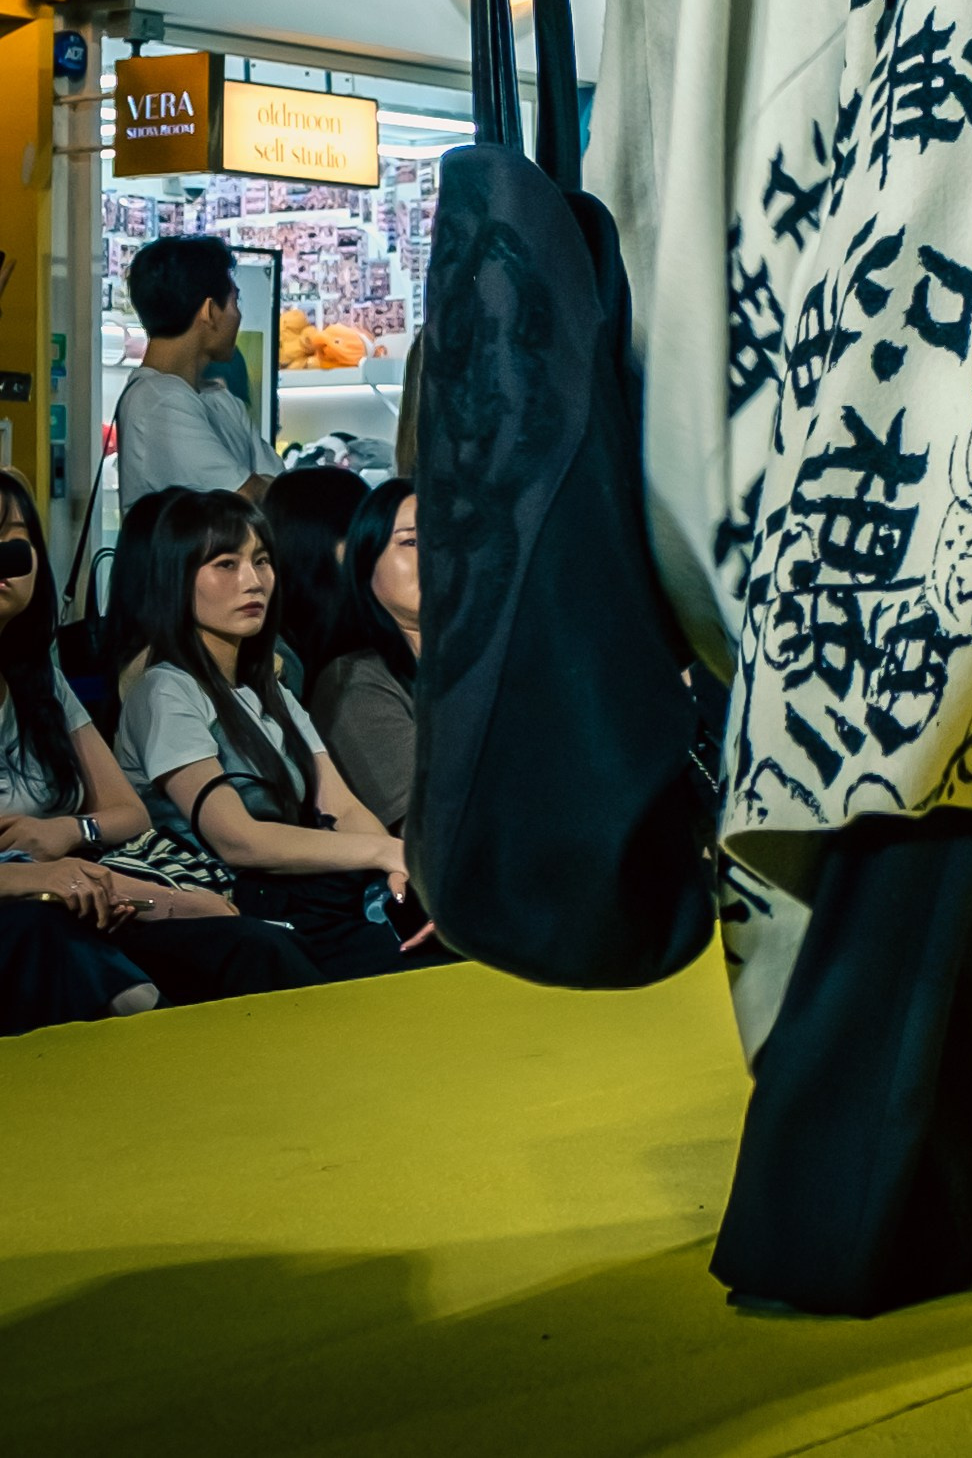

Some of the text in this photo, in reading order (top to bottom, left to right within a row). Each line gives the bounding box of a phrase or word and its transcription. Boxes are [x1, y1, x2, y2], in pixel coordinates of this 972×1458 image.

[126, 90, 195, 121] VERA
[257, 101, 343, 136] oldmoon
[290, 142, 347, 170] studio
